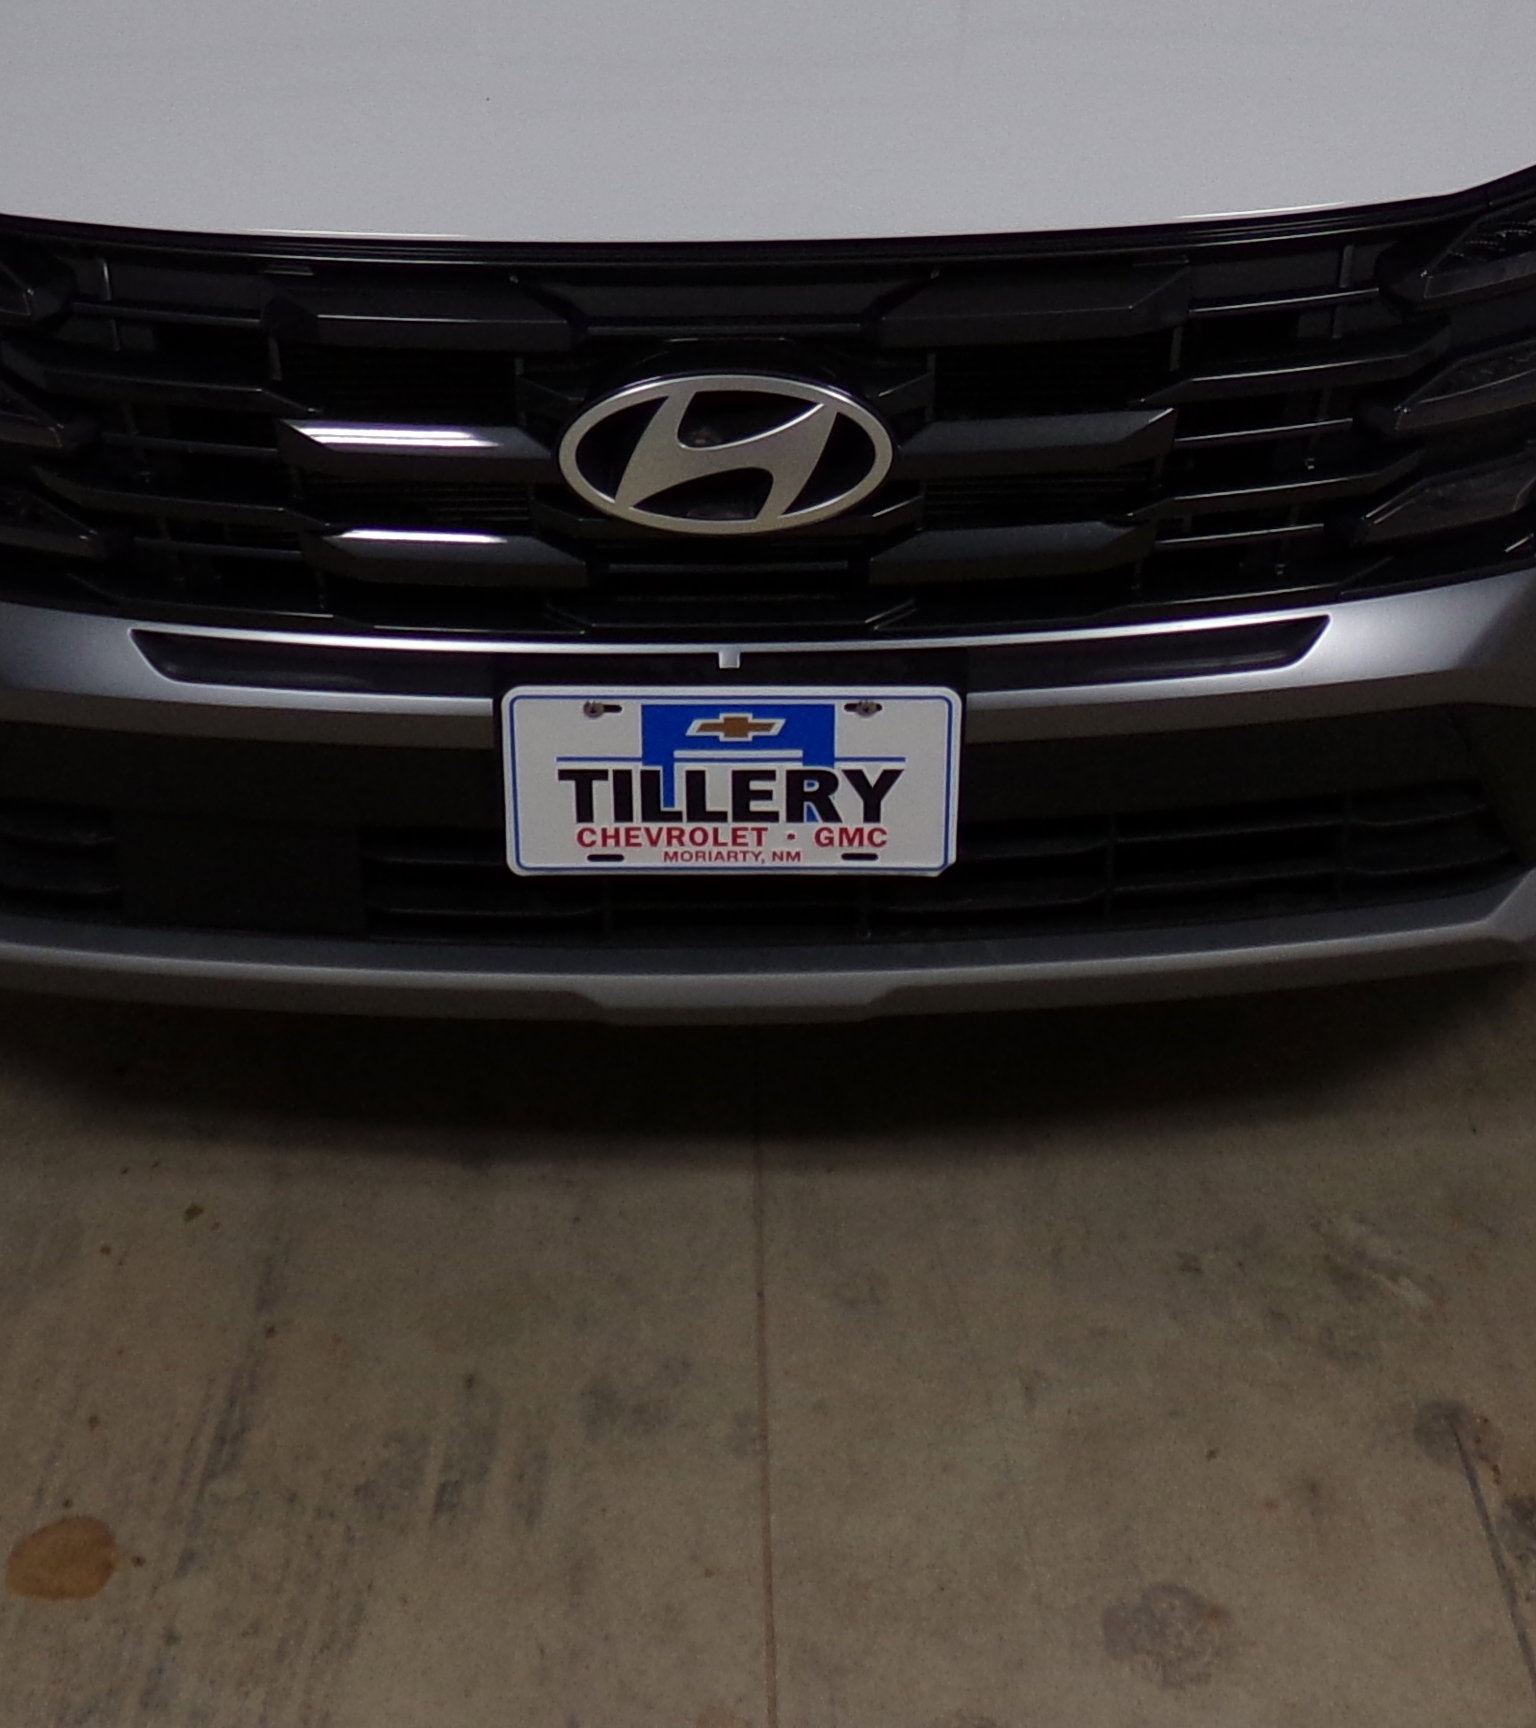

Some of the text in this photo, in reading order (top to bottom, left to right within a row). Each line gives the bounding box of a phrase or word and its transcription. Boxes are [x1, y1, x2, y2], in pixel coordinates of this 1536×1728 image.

[557, 768, 905, 824] TILLERY
[576, 826, 888, 849] CHEVROLET GMC
[663, 850, 802, 865] MORIARTY, NM
